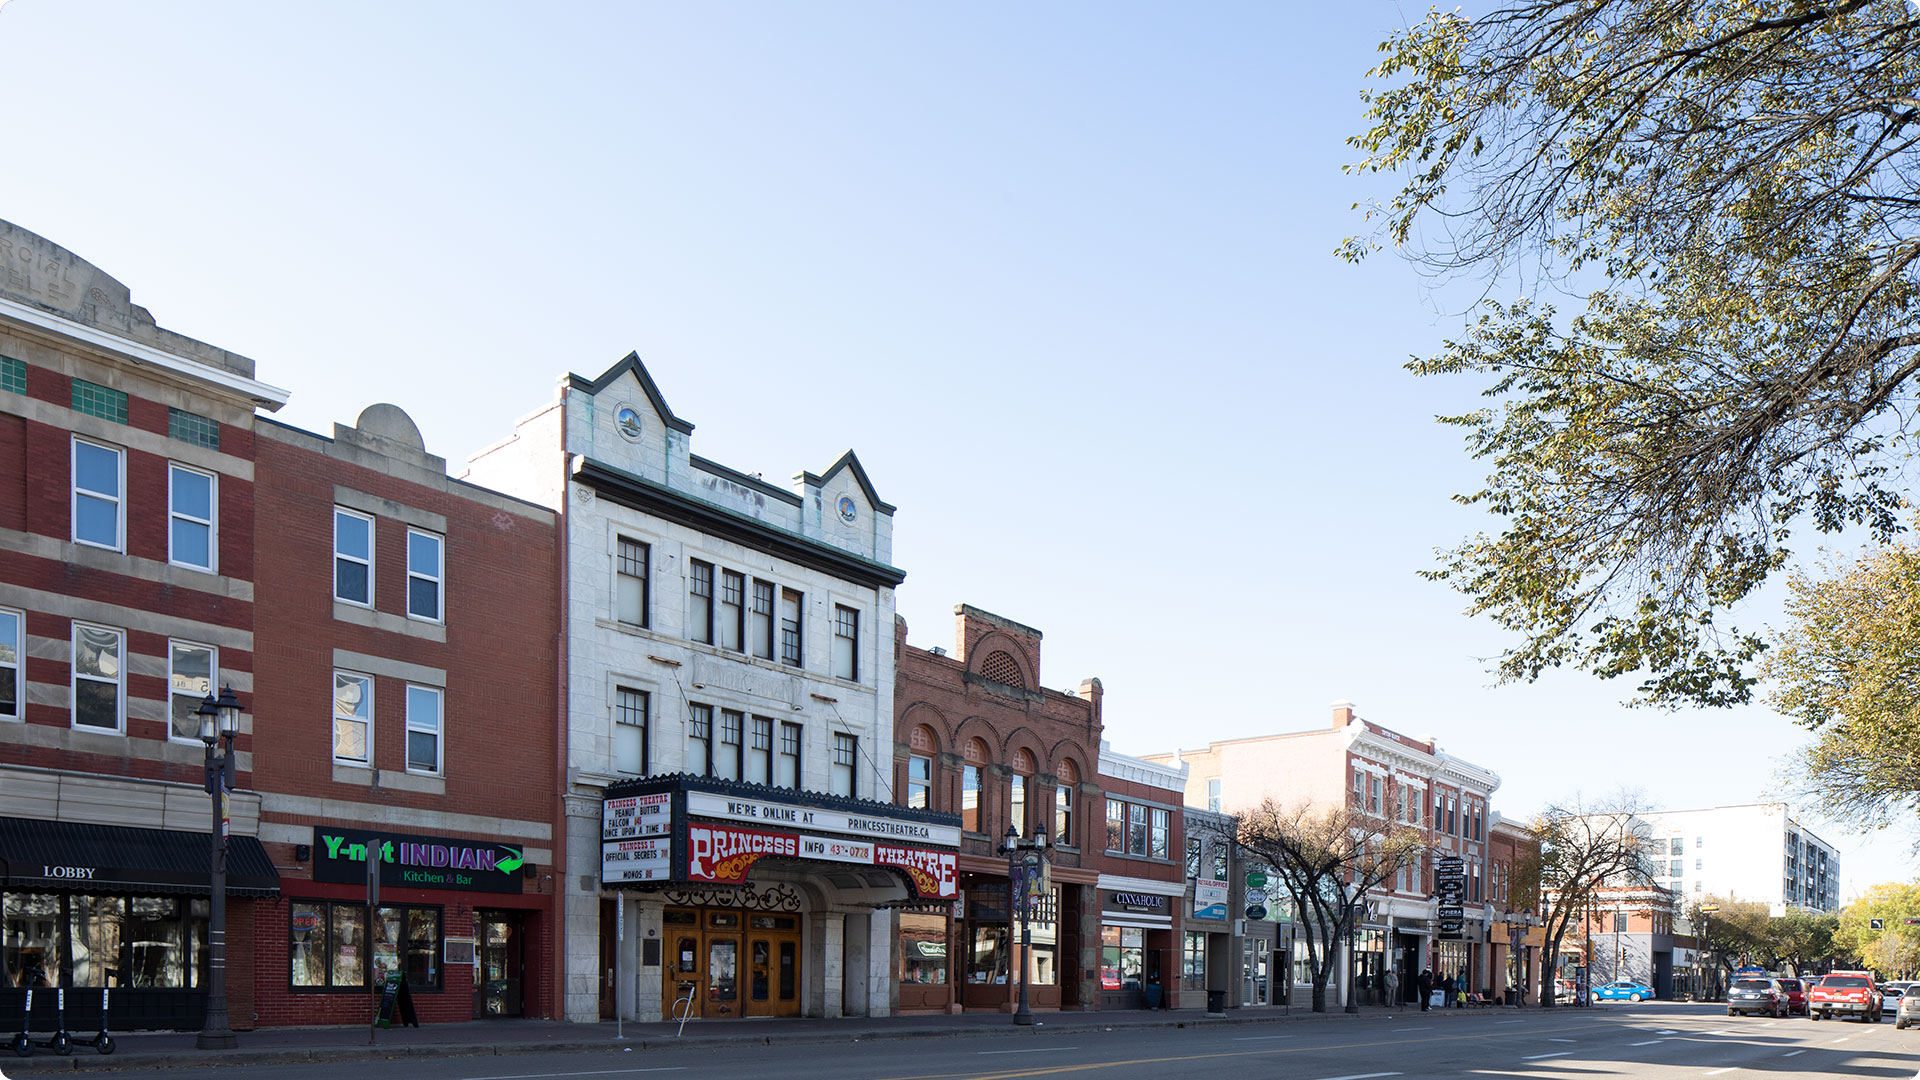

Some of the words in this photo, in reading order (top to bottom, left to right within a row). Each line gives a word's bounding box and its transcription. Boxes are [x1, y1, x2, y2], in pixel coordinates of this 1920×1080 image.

[608, 799, 637, 808] PRINCESS
[639, 794, 668, 805] THEATRE
[615, 808, 635, 817] PEANUT
[640, 805, 660, 815] BUTTER
[727, 802, 757, 817] WE'RE
[763, 806, 796, 821] ONLINE
[803, 812, 815, 824] AT
[608, 818, 630, 828] FALCON
[848, 818, 930, 839] PRINCESSTHEATRE.CA
[604, 828, 618, 838] ONCE
[622, 826, 636, 836] UPON
[638, 826, 643, 835] A
[646, 824, 660, 834] TIME
[619, 841, 648, 851] PRINCESS
[804, 841, 825, 853] INFO
[400, 842, 495, 871] INDIAN
[605, 852, 630, 861] OFFICIAL
[633, 849, 658, 860] SECRETS
[690, 827, 796, 880] PRINCESS
[43, 865, 96, 879] LOBBY
[403, 870, 445, 884] Kitchen
[446, 873, 454, 884] &
[456, 874, 473, 885] Bar
[623, 870, 643, 880] MONOS
[877, 847, 956, 897] THEATRE
[1116, 892, 1164, 908] CINNAHOLIC
[293, 917, 318, 927] OPEN
